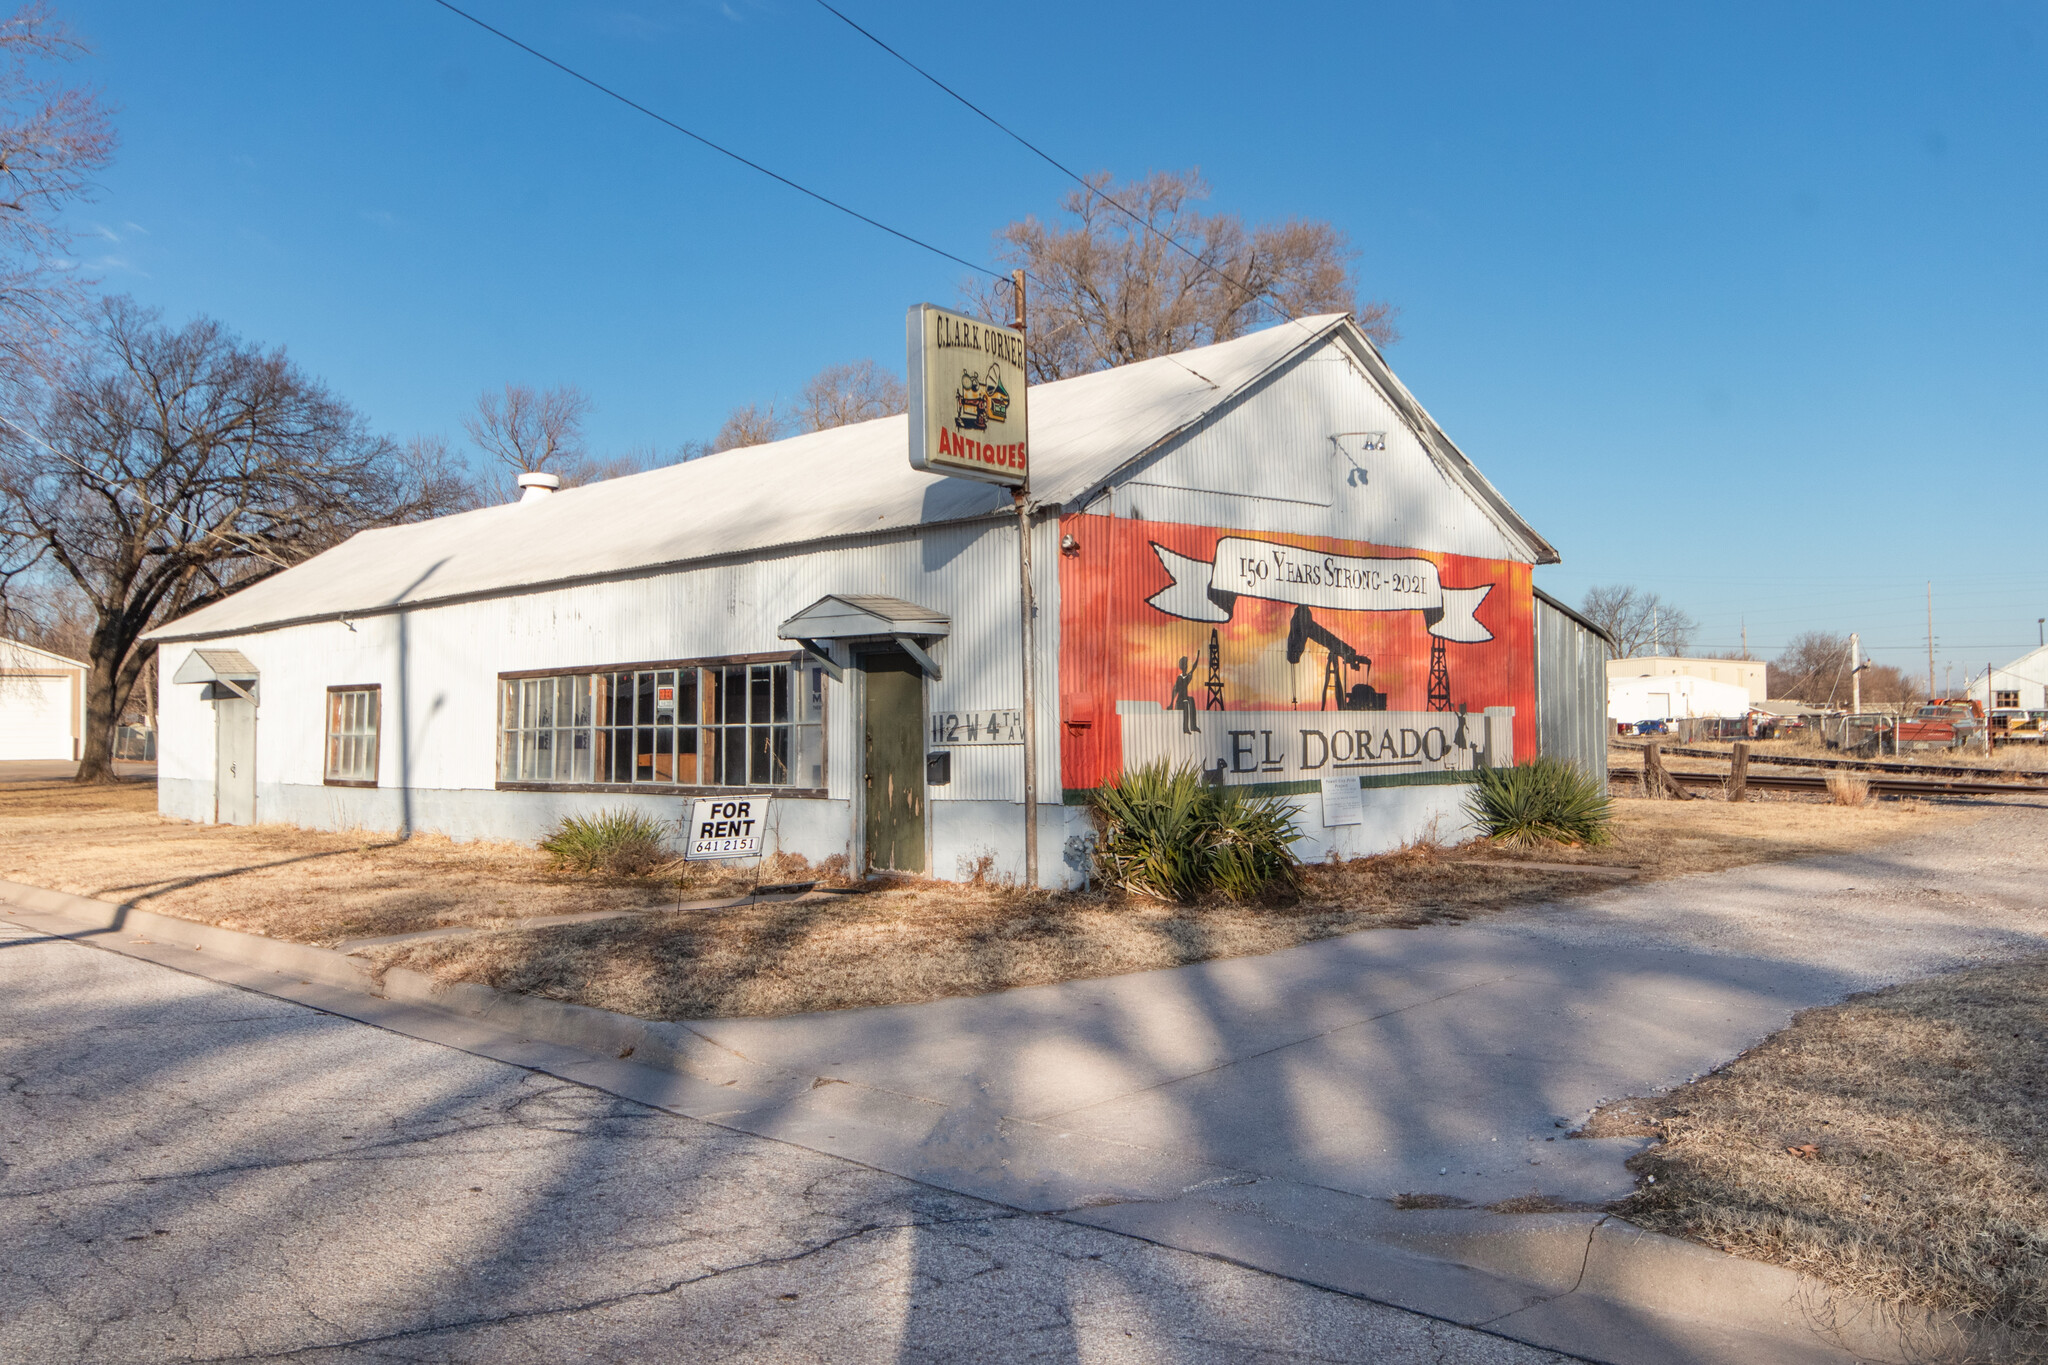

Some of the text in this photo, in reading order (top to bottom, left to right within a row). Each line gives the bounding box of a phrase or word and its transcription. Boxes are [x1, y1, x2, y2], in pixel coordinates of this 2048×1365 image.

[984, 329, 1023, 371] CORNER
[939, 426, 1026, 470] ANTIQUES
[1239, 557, 1269, 588] 150
[1272, 550, 1321, 585] YEARS
[1324, 557, 1381, 591] STRONG
[1393, 573, 1427, 595] 2021
[932, 714, 959, 742] 112
[966, 713, 979, 741] W
[1228, 726, 1447, 773] EL DORADO
[710, 802, 751, 819] FOR
[696, 839, 754, 853] 641 2151
[700, 820, 756, 839] RENT
